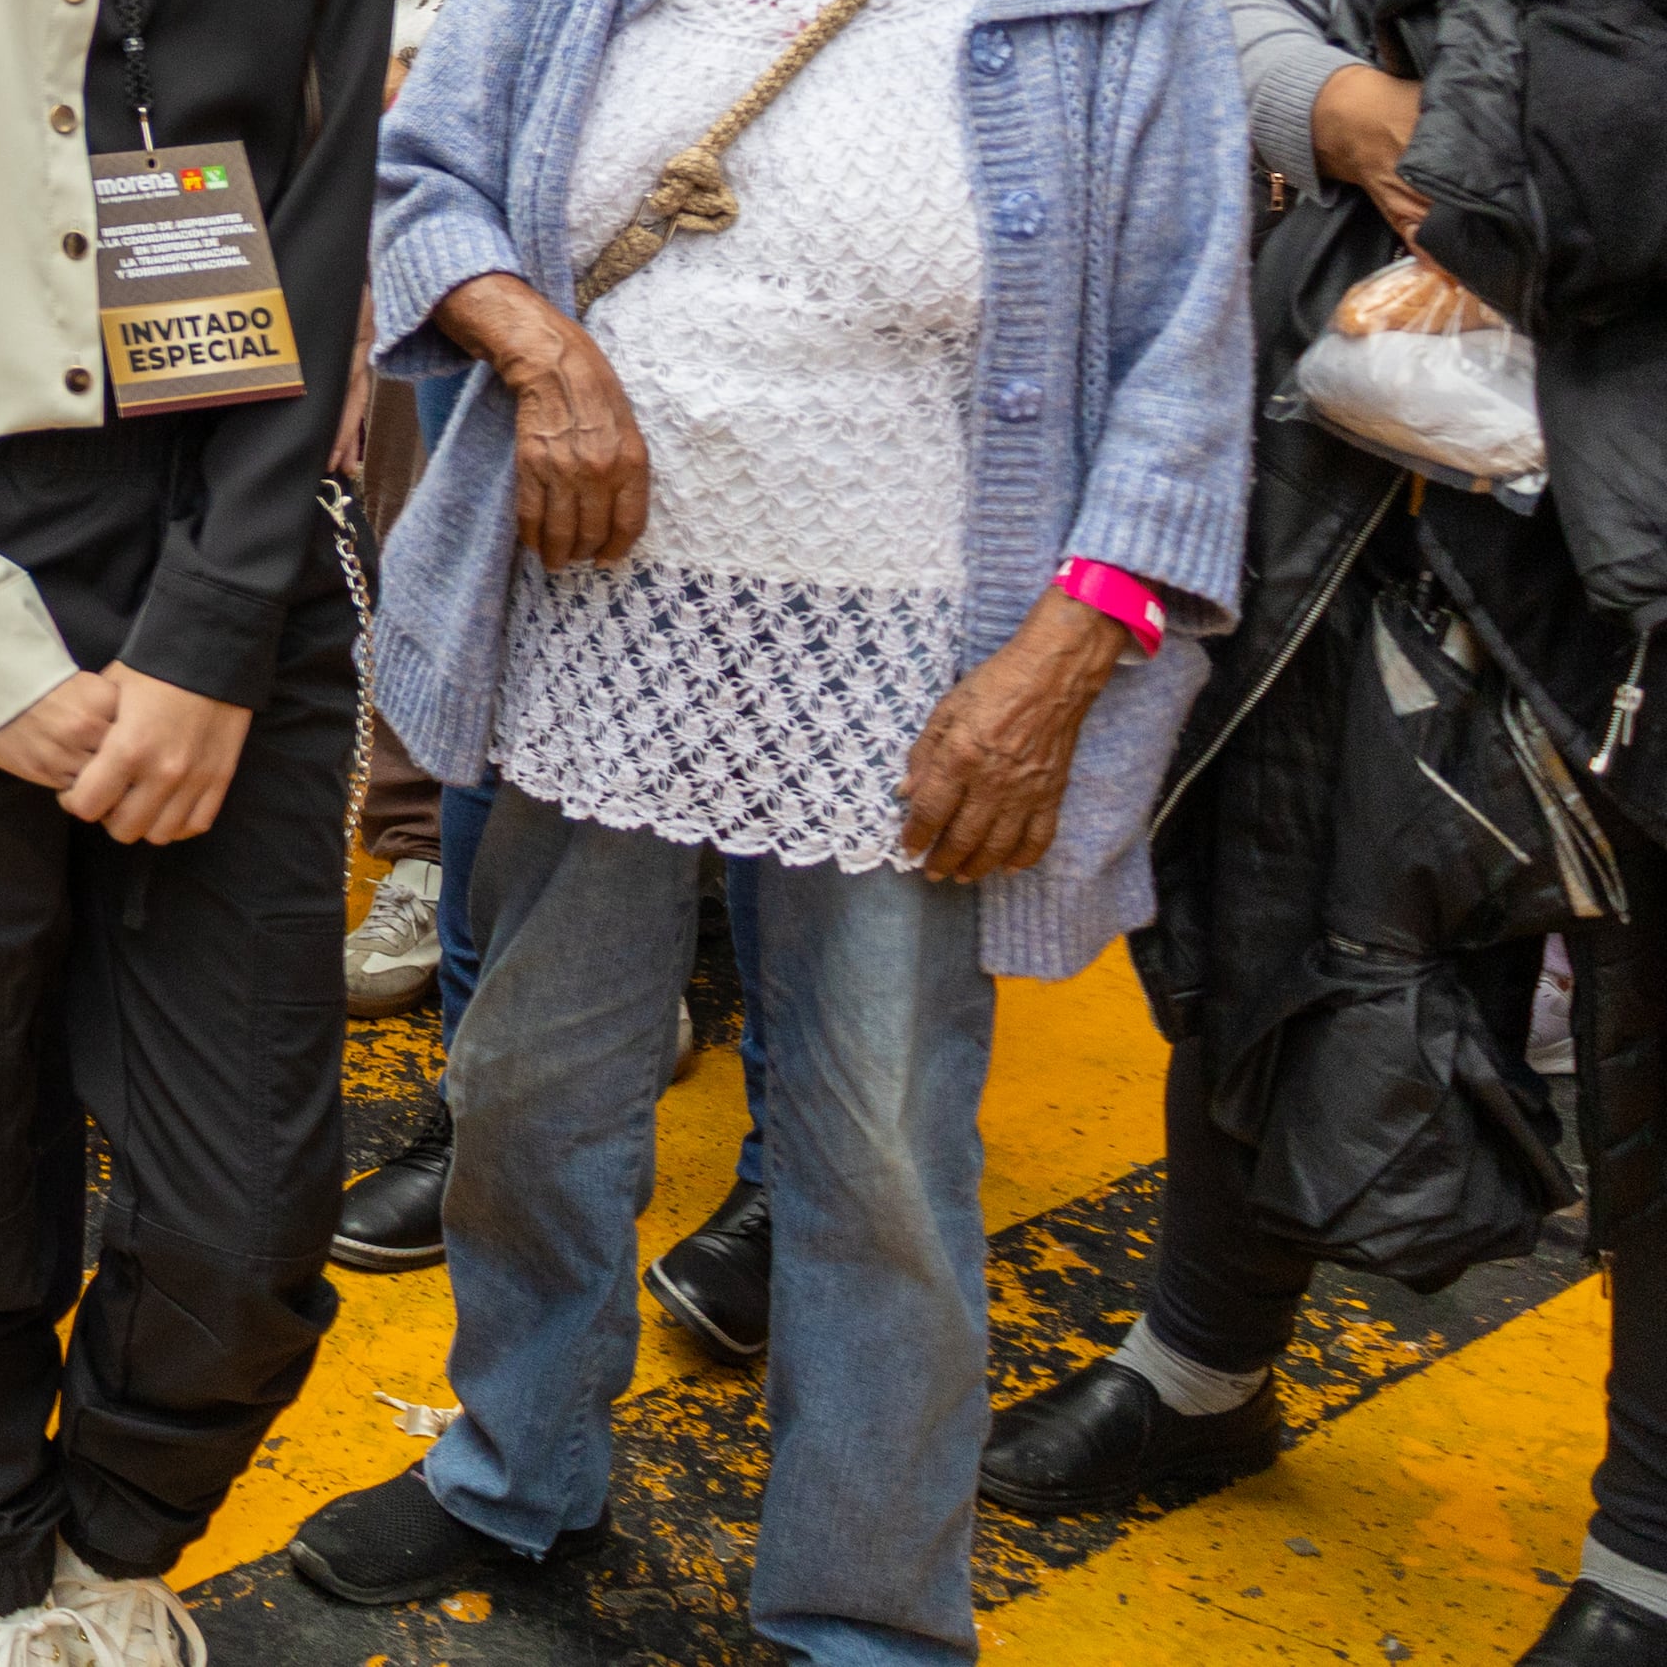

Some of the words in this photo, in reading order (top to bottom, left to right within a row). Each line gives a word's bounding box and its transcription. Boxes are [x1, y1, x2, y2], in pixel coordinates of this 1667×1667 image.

[94, 172, 178, 196] morena
[120, 307, 273, 346] INVITADO
[128, 334, 280, 373] ESPECIAL
